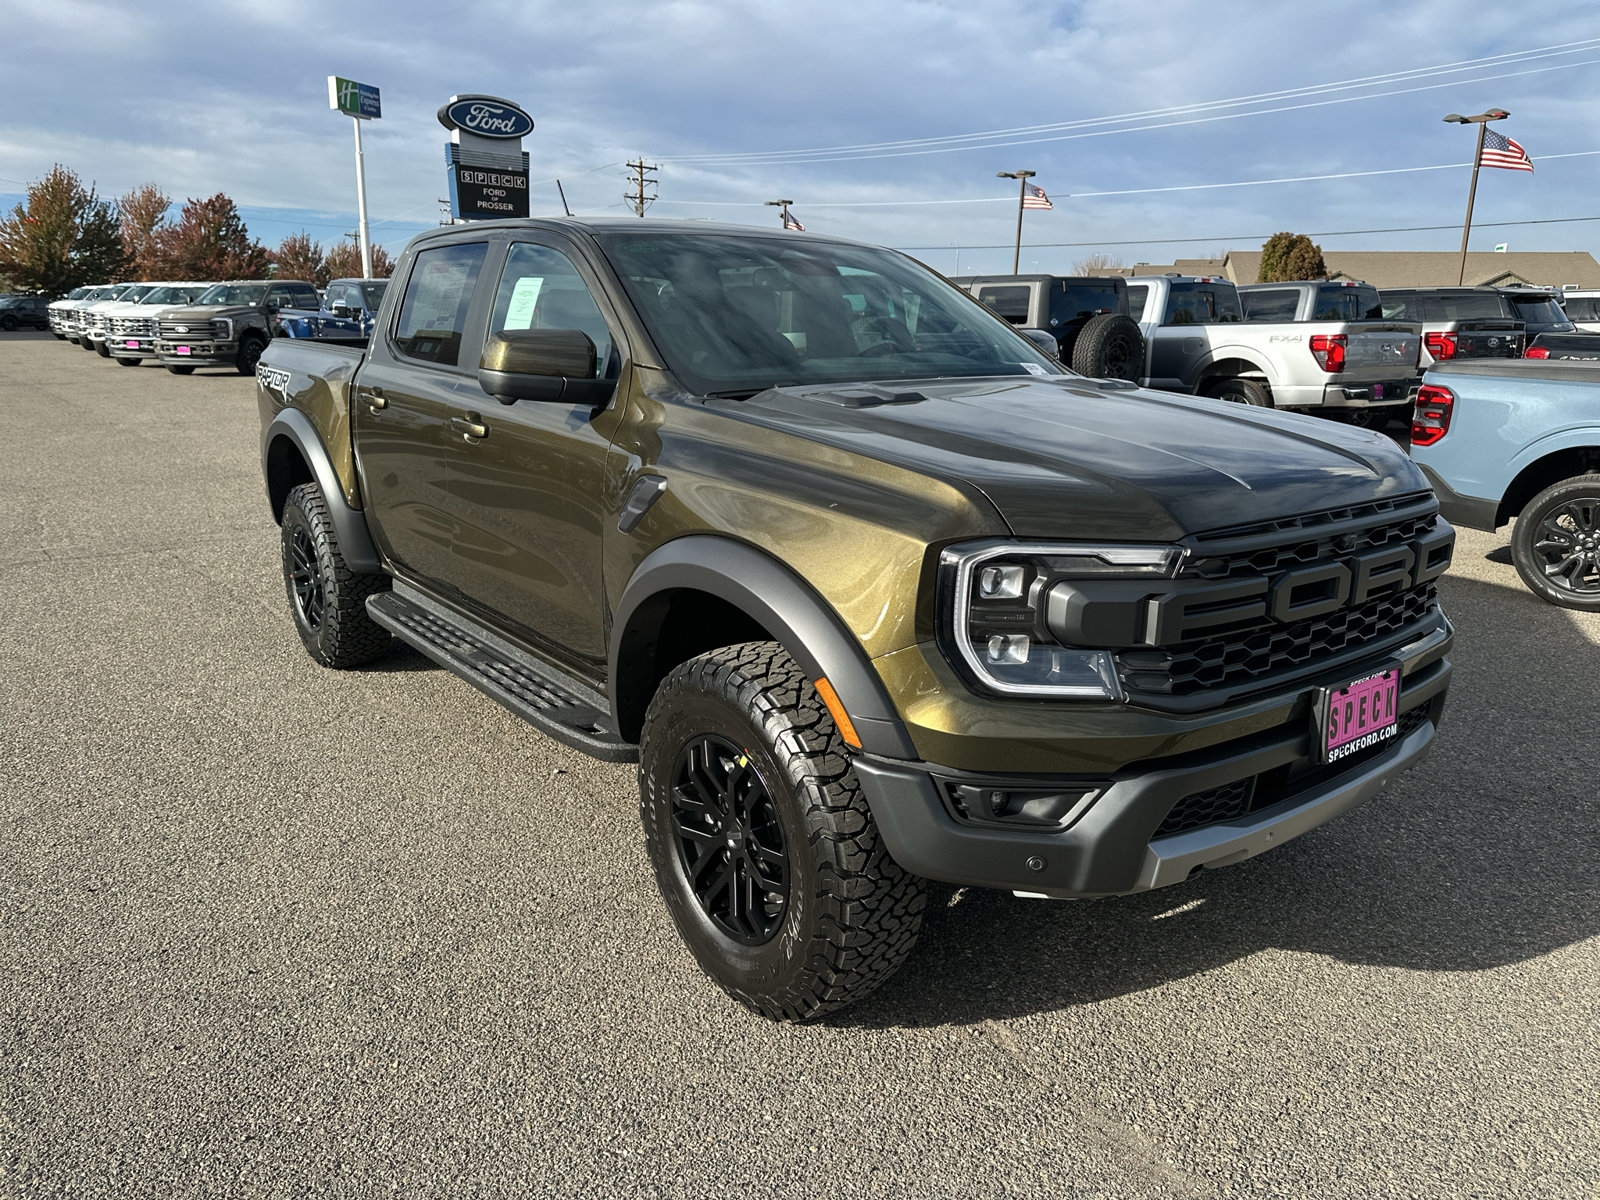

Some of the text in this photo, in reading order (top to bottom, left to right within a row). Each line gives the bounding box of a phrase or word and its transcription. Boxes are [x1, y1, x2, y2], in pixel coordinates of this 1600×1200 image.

[466, 105, 516, 132] Ford
[461, 171, 526, 188] SPECK
[483, 188, 506, 197] FORD
[477, 201, 513, 211] PROSSER
[1269, 335, 1303, 343] FX4
[257, 365, 291, 402] RAPTOR
[1349, 669, 1387, 687] SPECK FORD
[1329, 685, 1394, 740] SPECK
[1328, 723, 1397, 763] SPECKFORD.COM
